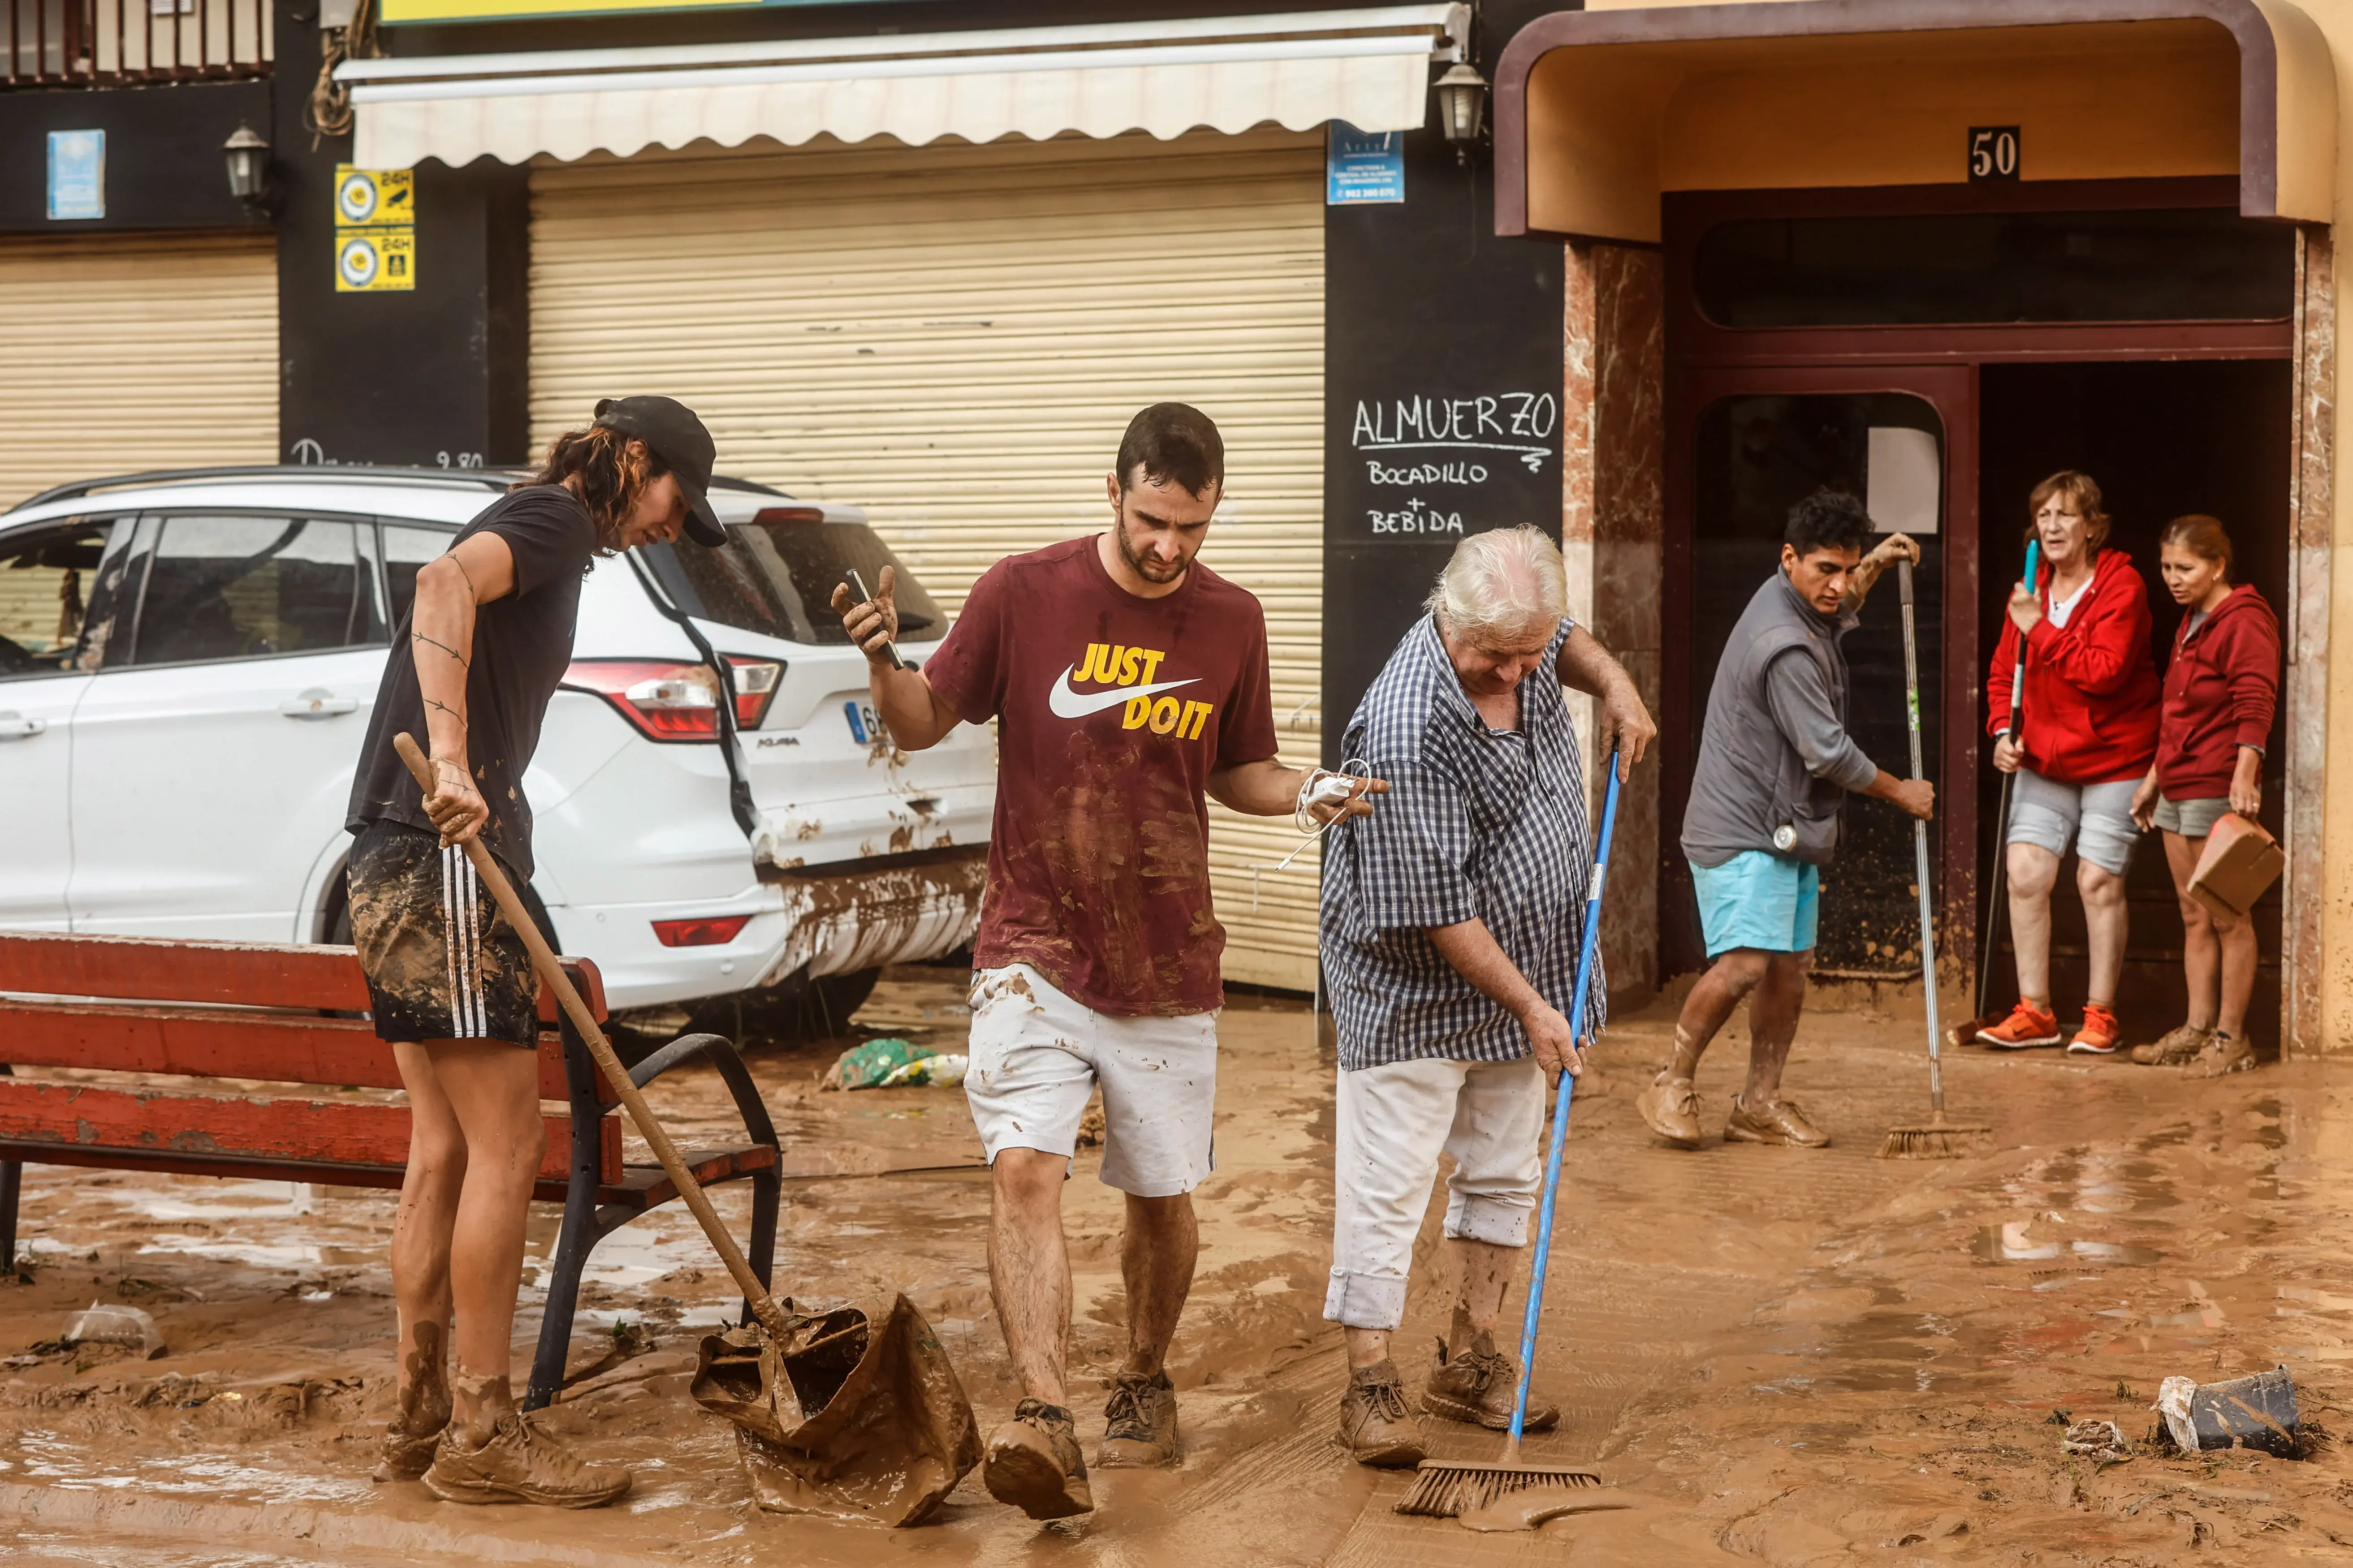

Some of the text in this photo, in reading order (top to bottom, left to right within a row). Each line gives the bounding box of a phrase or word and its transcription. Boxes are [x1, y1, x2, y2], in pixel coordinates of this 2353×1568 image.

[1973, 131, 2016, 176] 50
[1352, 392, 1556, 446] ALMUERZO
[1366, 461, 1488, 485] BOCADILLO
[1366, 510, 1464, 534] BEBIDA
[1073, 643, 1165, 686] JUST
